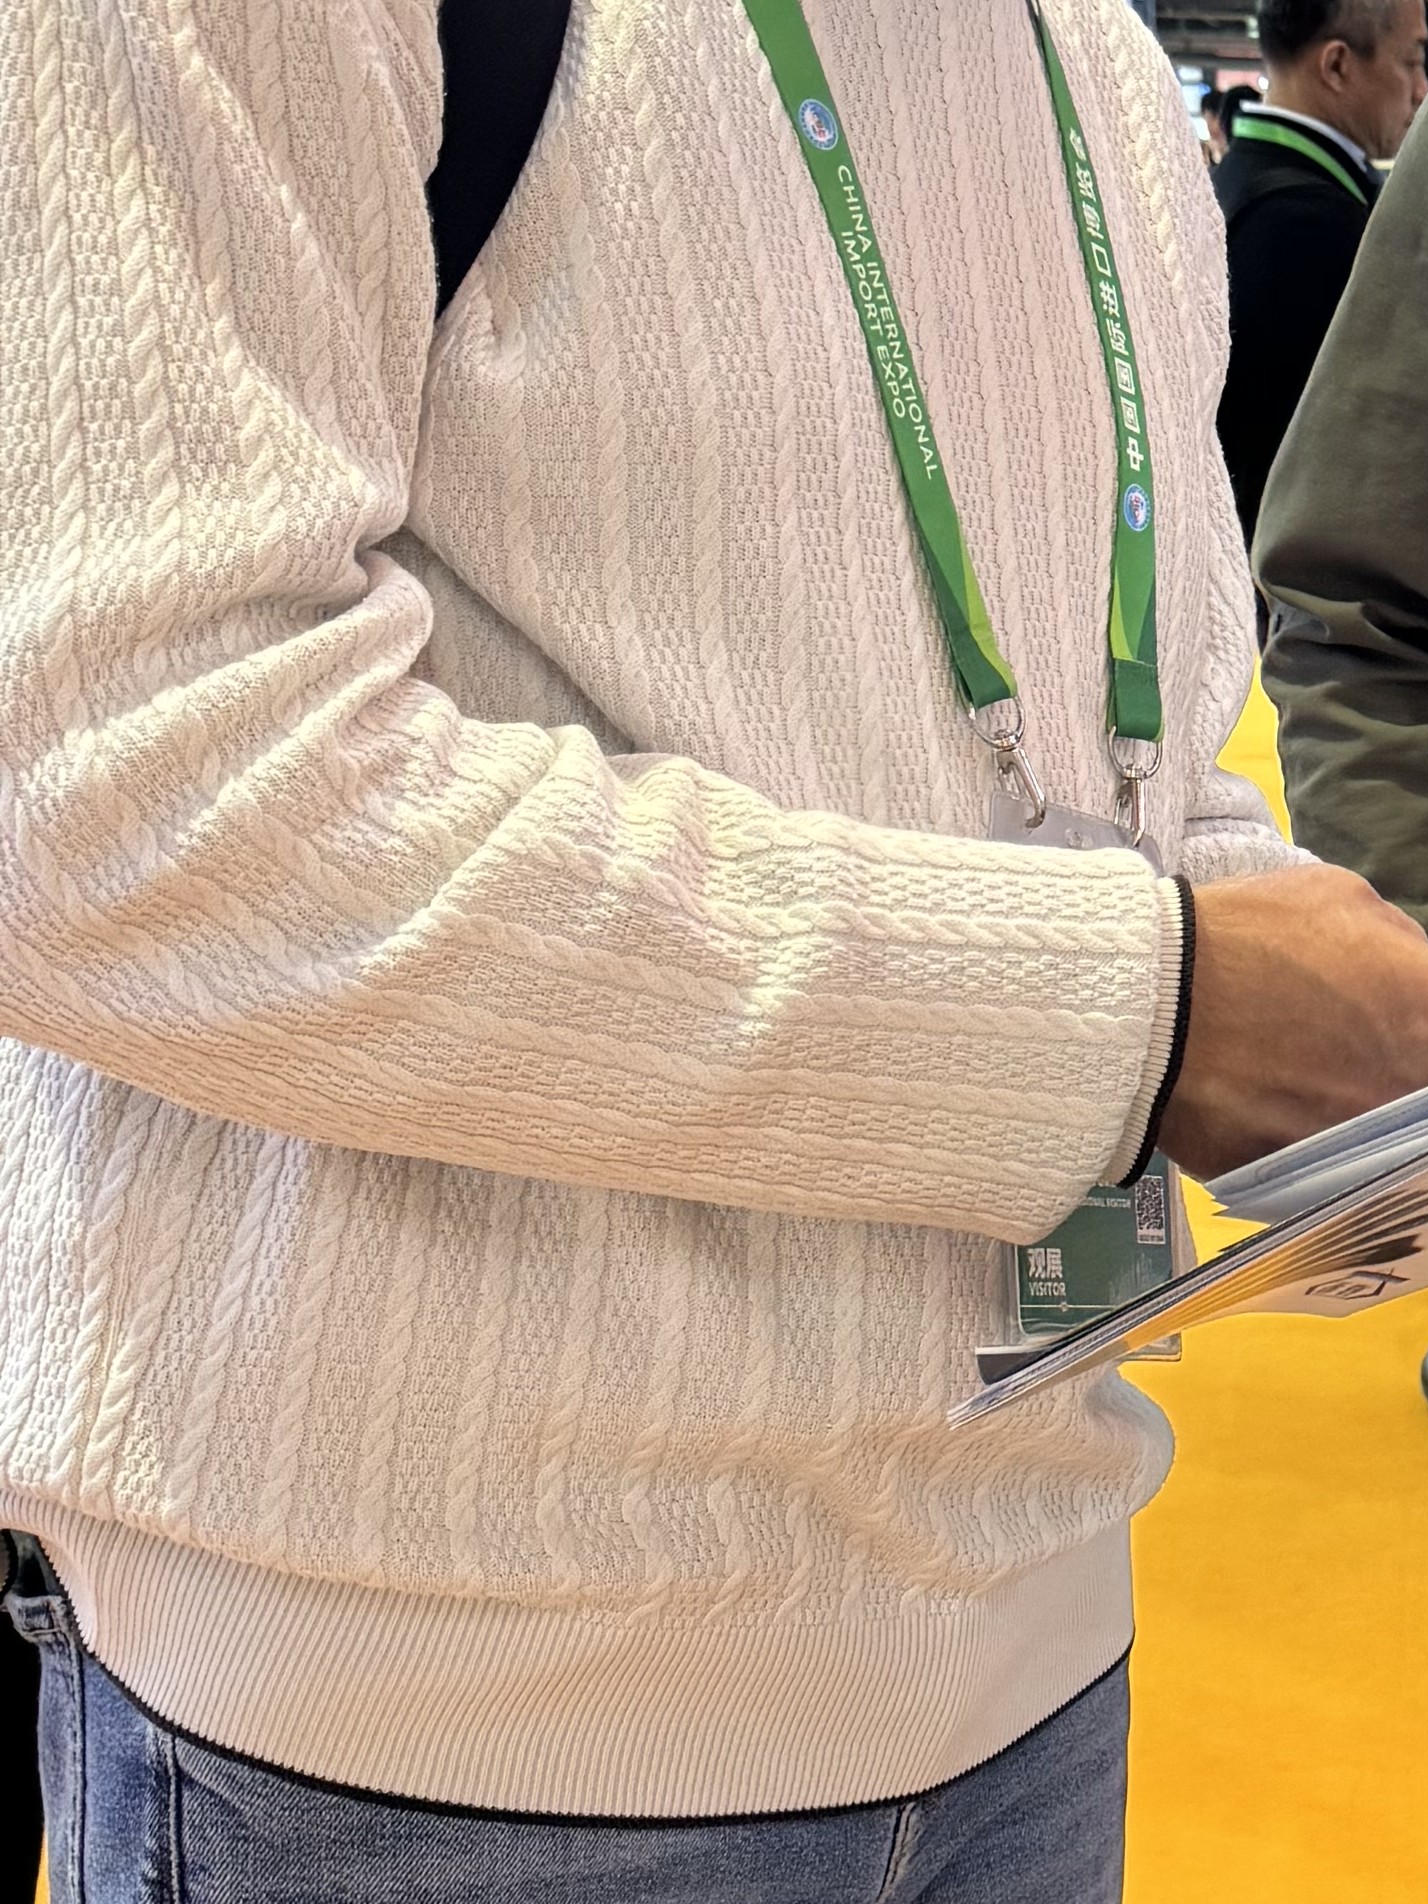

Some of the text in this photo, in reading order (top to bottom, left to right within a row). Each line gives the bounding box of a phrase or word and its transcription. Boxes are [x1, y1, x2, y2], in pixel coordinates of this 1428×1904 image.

[838, 165, 938, 480] CHINA INTERNATIONAL
[841, 231, 906, 418] IMPORT EXPO
[1070, 127, 1145, 472] 中国国际进口博览会
[1027, 1247, 1063, 1279] 观展
[1028, 1282, 1067, 1296] VISITOR
